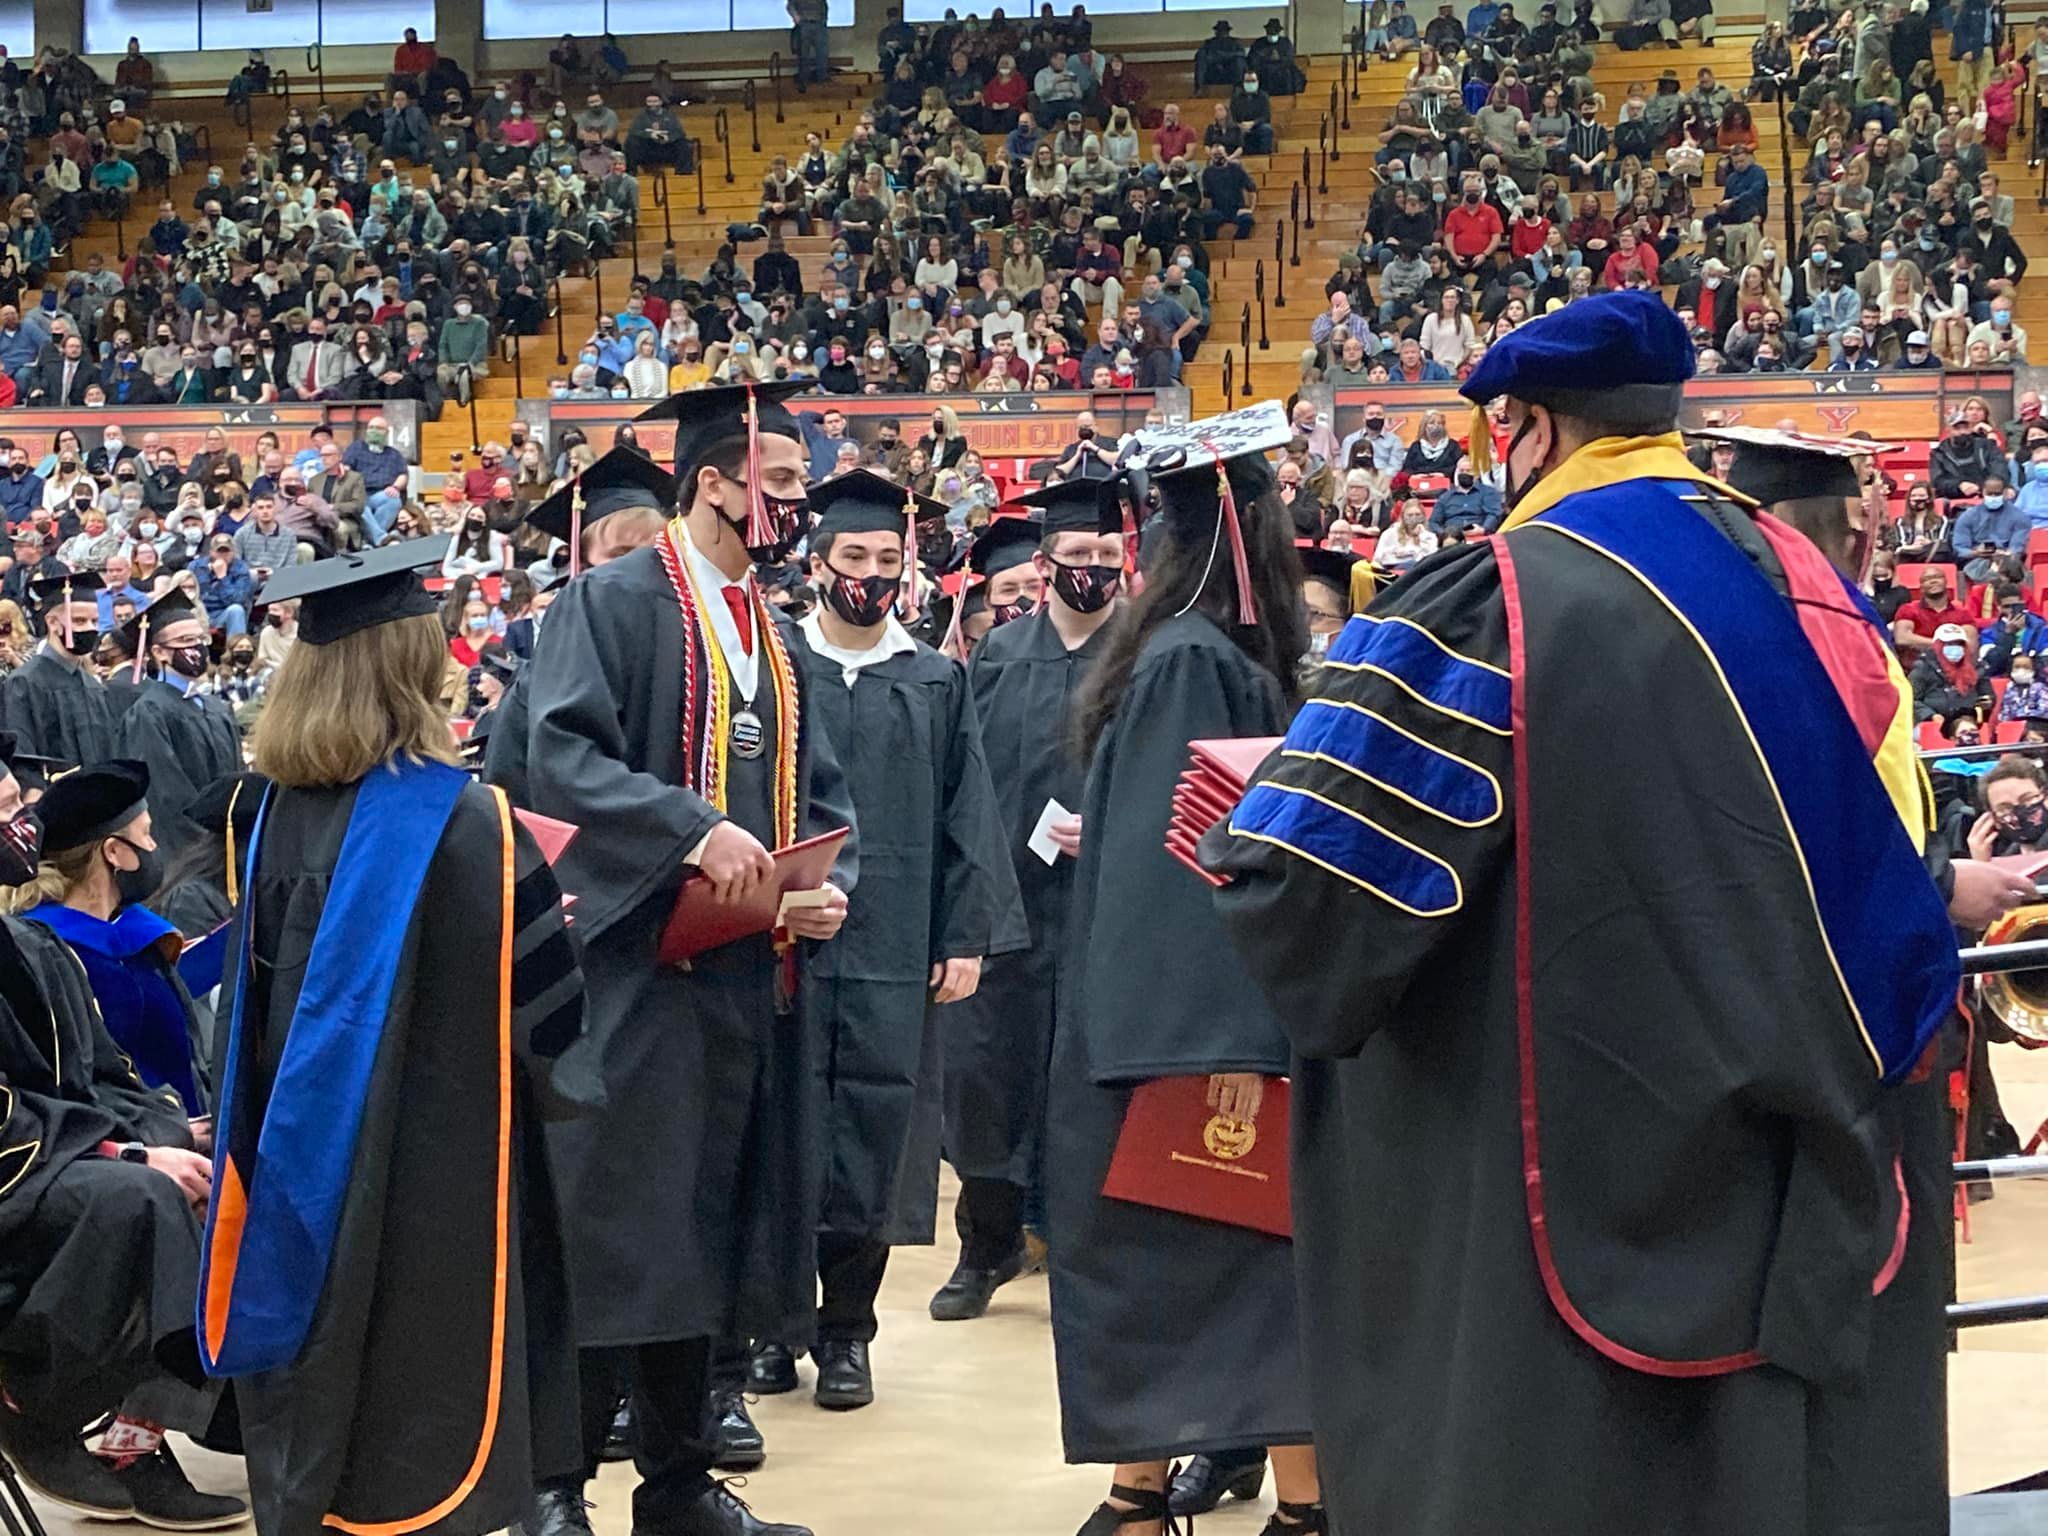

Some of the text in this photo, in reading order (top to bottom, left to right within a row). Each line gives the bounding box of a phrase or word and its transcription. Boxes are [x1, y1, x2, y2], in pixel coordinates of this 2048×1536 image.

[1817, 407, 1859, 432] Y
[388, 426, 410, 447] 14
[907, 423, 1079, 449] PGUIN CLU
